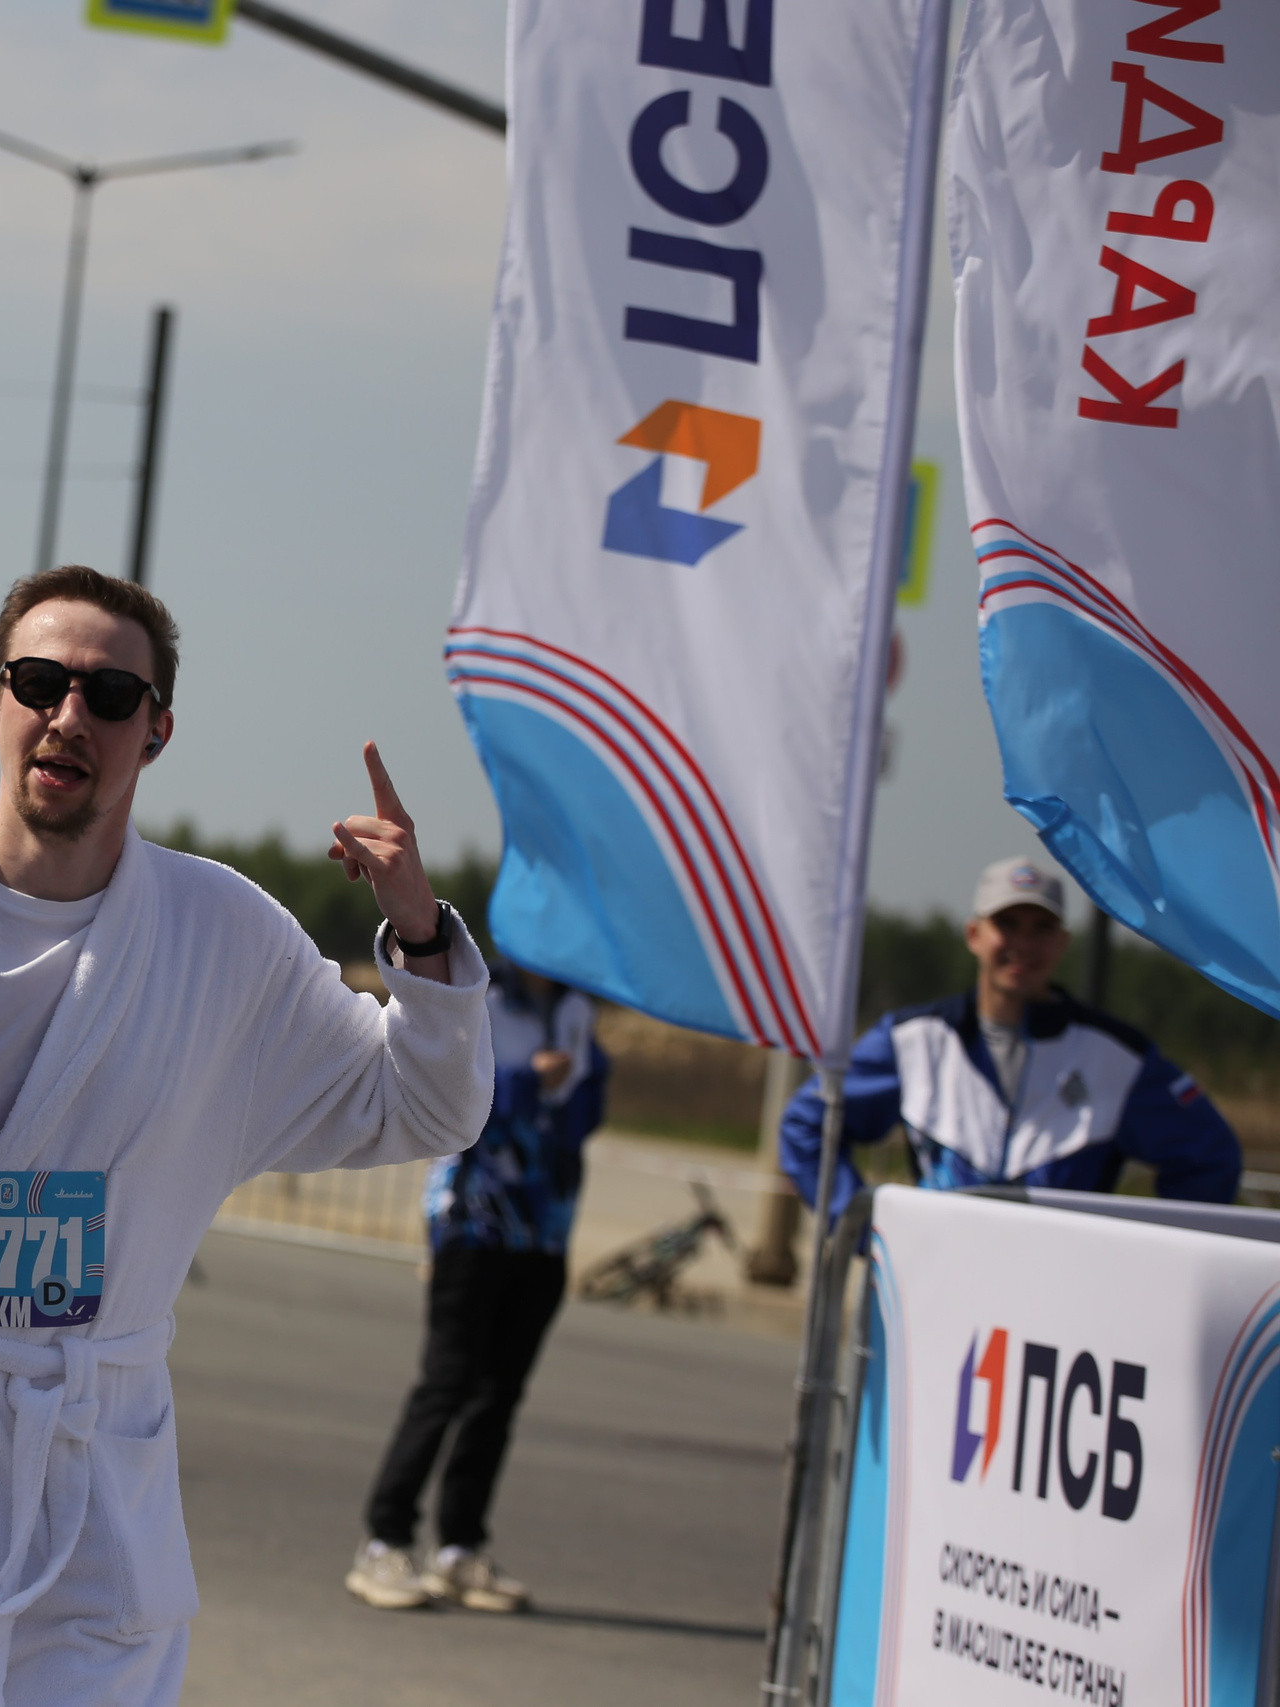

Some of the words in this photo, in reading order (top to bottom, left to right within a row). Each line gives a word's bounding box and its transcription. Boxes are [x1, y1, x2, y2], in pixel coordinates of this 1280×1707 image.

[43, 1282, 66, 1306] D
[1012, 1340, 1146, 1522] ПСБ
[939, 1542, 1029, 1608] СКОРОСТЬ
[1033, 1570, 1048, 1615] И
[1049, 1576, 1100, 1633] СИЛА
[932, 1608, 944, 1651] В
[946, 1614, 1047, 1686] МАСШТАБЕ
[1049, 1648, 1127, 1707] СТРАНЫ
